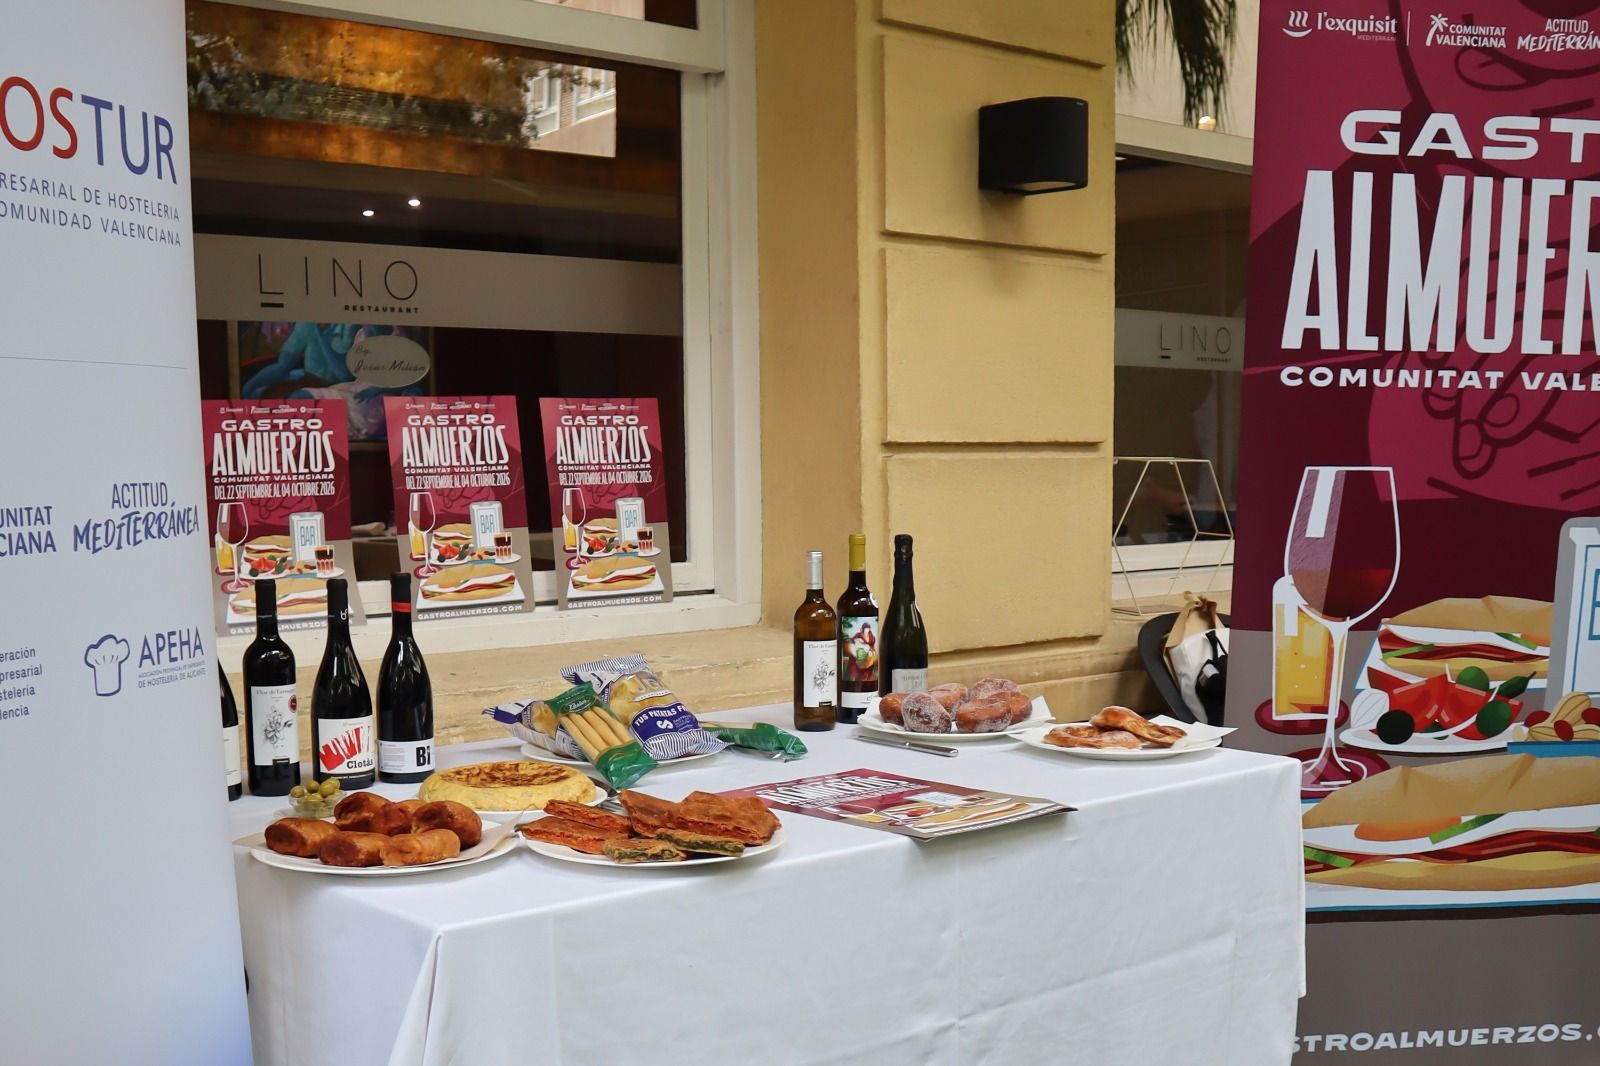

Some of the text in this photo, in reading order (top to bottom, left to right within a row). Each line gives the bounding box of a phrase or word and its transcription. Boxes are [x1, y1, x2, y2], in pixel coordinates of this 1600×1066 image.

[1317, 11, 1398, 36] l'exquisit
[1450, 24, 1506, 37] COMUNITAT
[1545, 18, 1589, 33] ACTITUD
[1436, 34, 1506, 49] VALENCIANA
[0, 76, 177, 185] OSTUR
[1340, 109, 1600, 164] GAST
[0, 171, 76, 201] RESARIAL
[83, 187, 101, 206] DE
[101, 217, 181, 247] VALENCIANA
[1280, 170, 1600, 356] ALMUER
[258, 253, 418, 301] LINO
[344, 305, 420, 313] RESTAURANT
[1160, 321, 1231, 354] LINO
[1280, 365, 1504, 389] COMUNITAT
[221, 418, 323, 431] GASTRO
[407, 413, 495, 426] GASTRO
[561, 415, 639, 426] GASTRO
[212, 430, 336, 476] ALMUERZOS
[402, 424, 510, 468] ALMUERZOS
[556, 425, 652, 464] ALMUERZOS
[213, 473, 335, 484] COMUNITAT VALENCIANA
[404, 465, 510, 475] COMUNITAT VALENCIANA
[112, 482, 168, 509] ACTITUD
[214, 481, 335, 500] DEL 22 SEPTIEMBRE AL 04 OCTUBRE 2026
[73, 500, 200, 554] MEDITERRÁNEA
[300, 525, 316, 546] BAR
[479, 513, 495, 535] BAR
[138, 626, 204, 669] APEHA
[634, 713, 649, 727] TUS
[648, 708, 677, 718] PATATAS
[416, 745, 431, 767] Bi
[1292, 1023, 1600, 1054] TROALMUERZOS.
